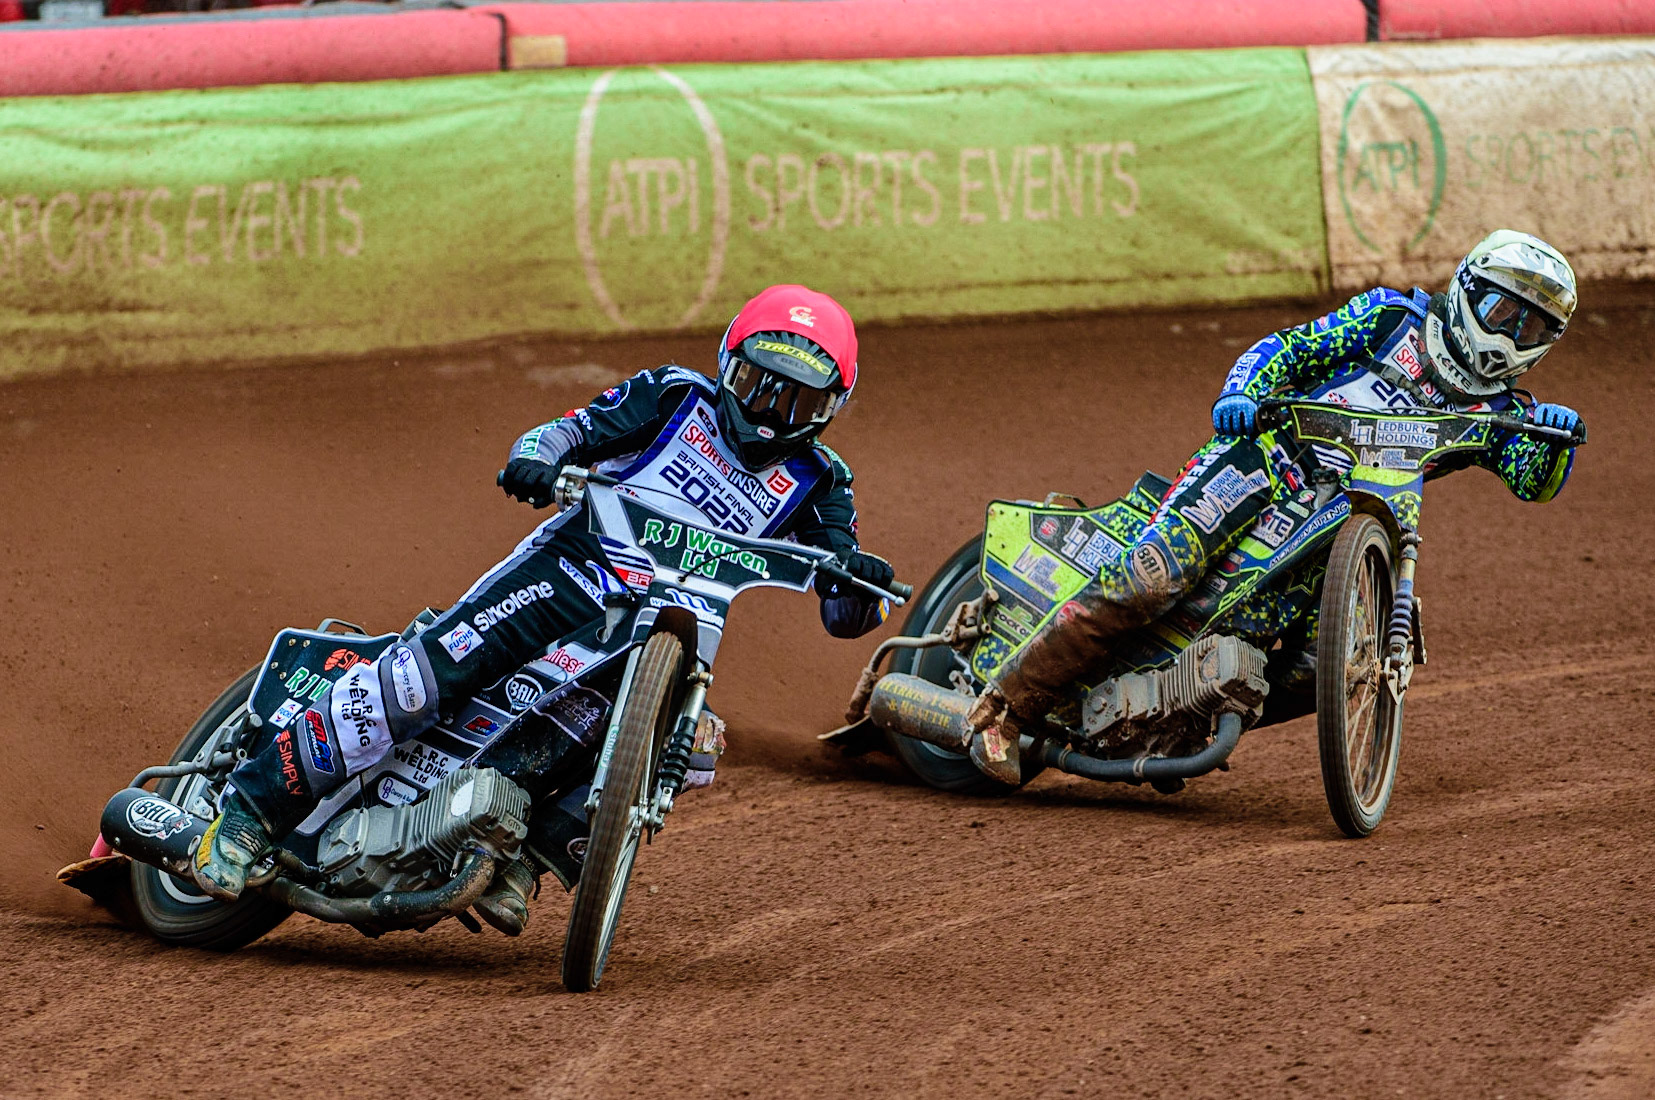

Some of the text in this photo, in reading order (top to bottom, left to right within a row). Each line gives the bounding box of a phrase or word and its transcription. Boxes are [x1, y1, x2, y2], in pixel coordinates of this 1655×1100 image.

[744, 141, 1140, 231] SPORTS EVENTS
[185, 175, 364, 265] EVENTS
[1396, 348, 1435, 395] SPOS
[1376, 433, 1436, 447] HOLDINGS
[1377, 422, 1428, 434] LEDBURY
[684, 425, 777, 516] SPORTS INSURE
[766, 469, 794, 495] 13
[1206, 467, 1238, 493] LEDBURY
[676, 450, 754, 527] BRITISH FINAL
[1216, 475, 1245, 500] WELDING
[645, 518, 767, 574] R J Warren
[1080, 548, 1100, 568] HOLD
[1089, 535, 1121, 558] LEDBU
[680, 550, 720, 579] Ltd
[474, 581, 555, 632] Silkolene
[449, 629, 474, 652] FUCHS
[341, 703, 350, 721] Ltd
[350, 674, 371, 748] WELDING
[278, 741, 304, 796] SIMPLY
[393, 746, 449, 780] WELDING
[413, 744, 449, 767] A.R.C
[412, 771, 428, 784] Ltd
